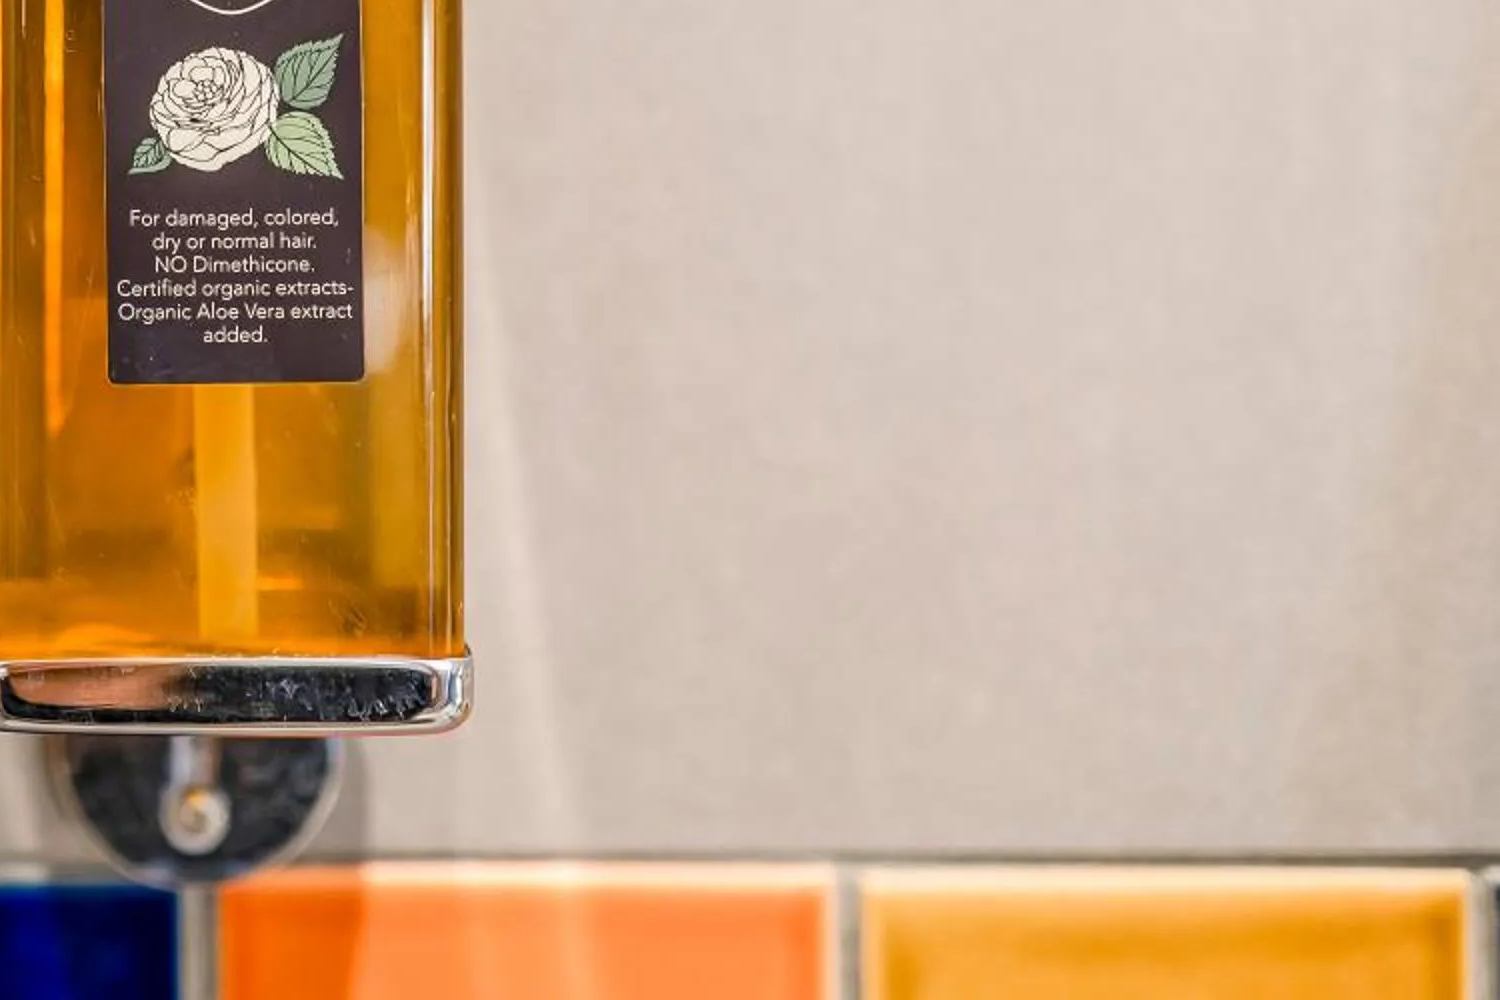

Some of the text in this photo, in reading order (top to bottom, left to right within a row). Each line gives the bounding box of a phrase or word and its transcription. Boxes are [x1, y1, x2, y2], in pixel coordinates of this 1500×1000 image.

[129, 208, 339, 230] For damaged, colored,
[152, 232, 316, 254] dry or normal hair.
[155, 256, 315, 273] NO Dimethicone.
[117, 280, 354, 301] Certified organic extracts-
[118, 303, 353, 325] Organic Aloe Vera extract
[204, 326, 268, 343] added.
